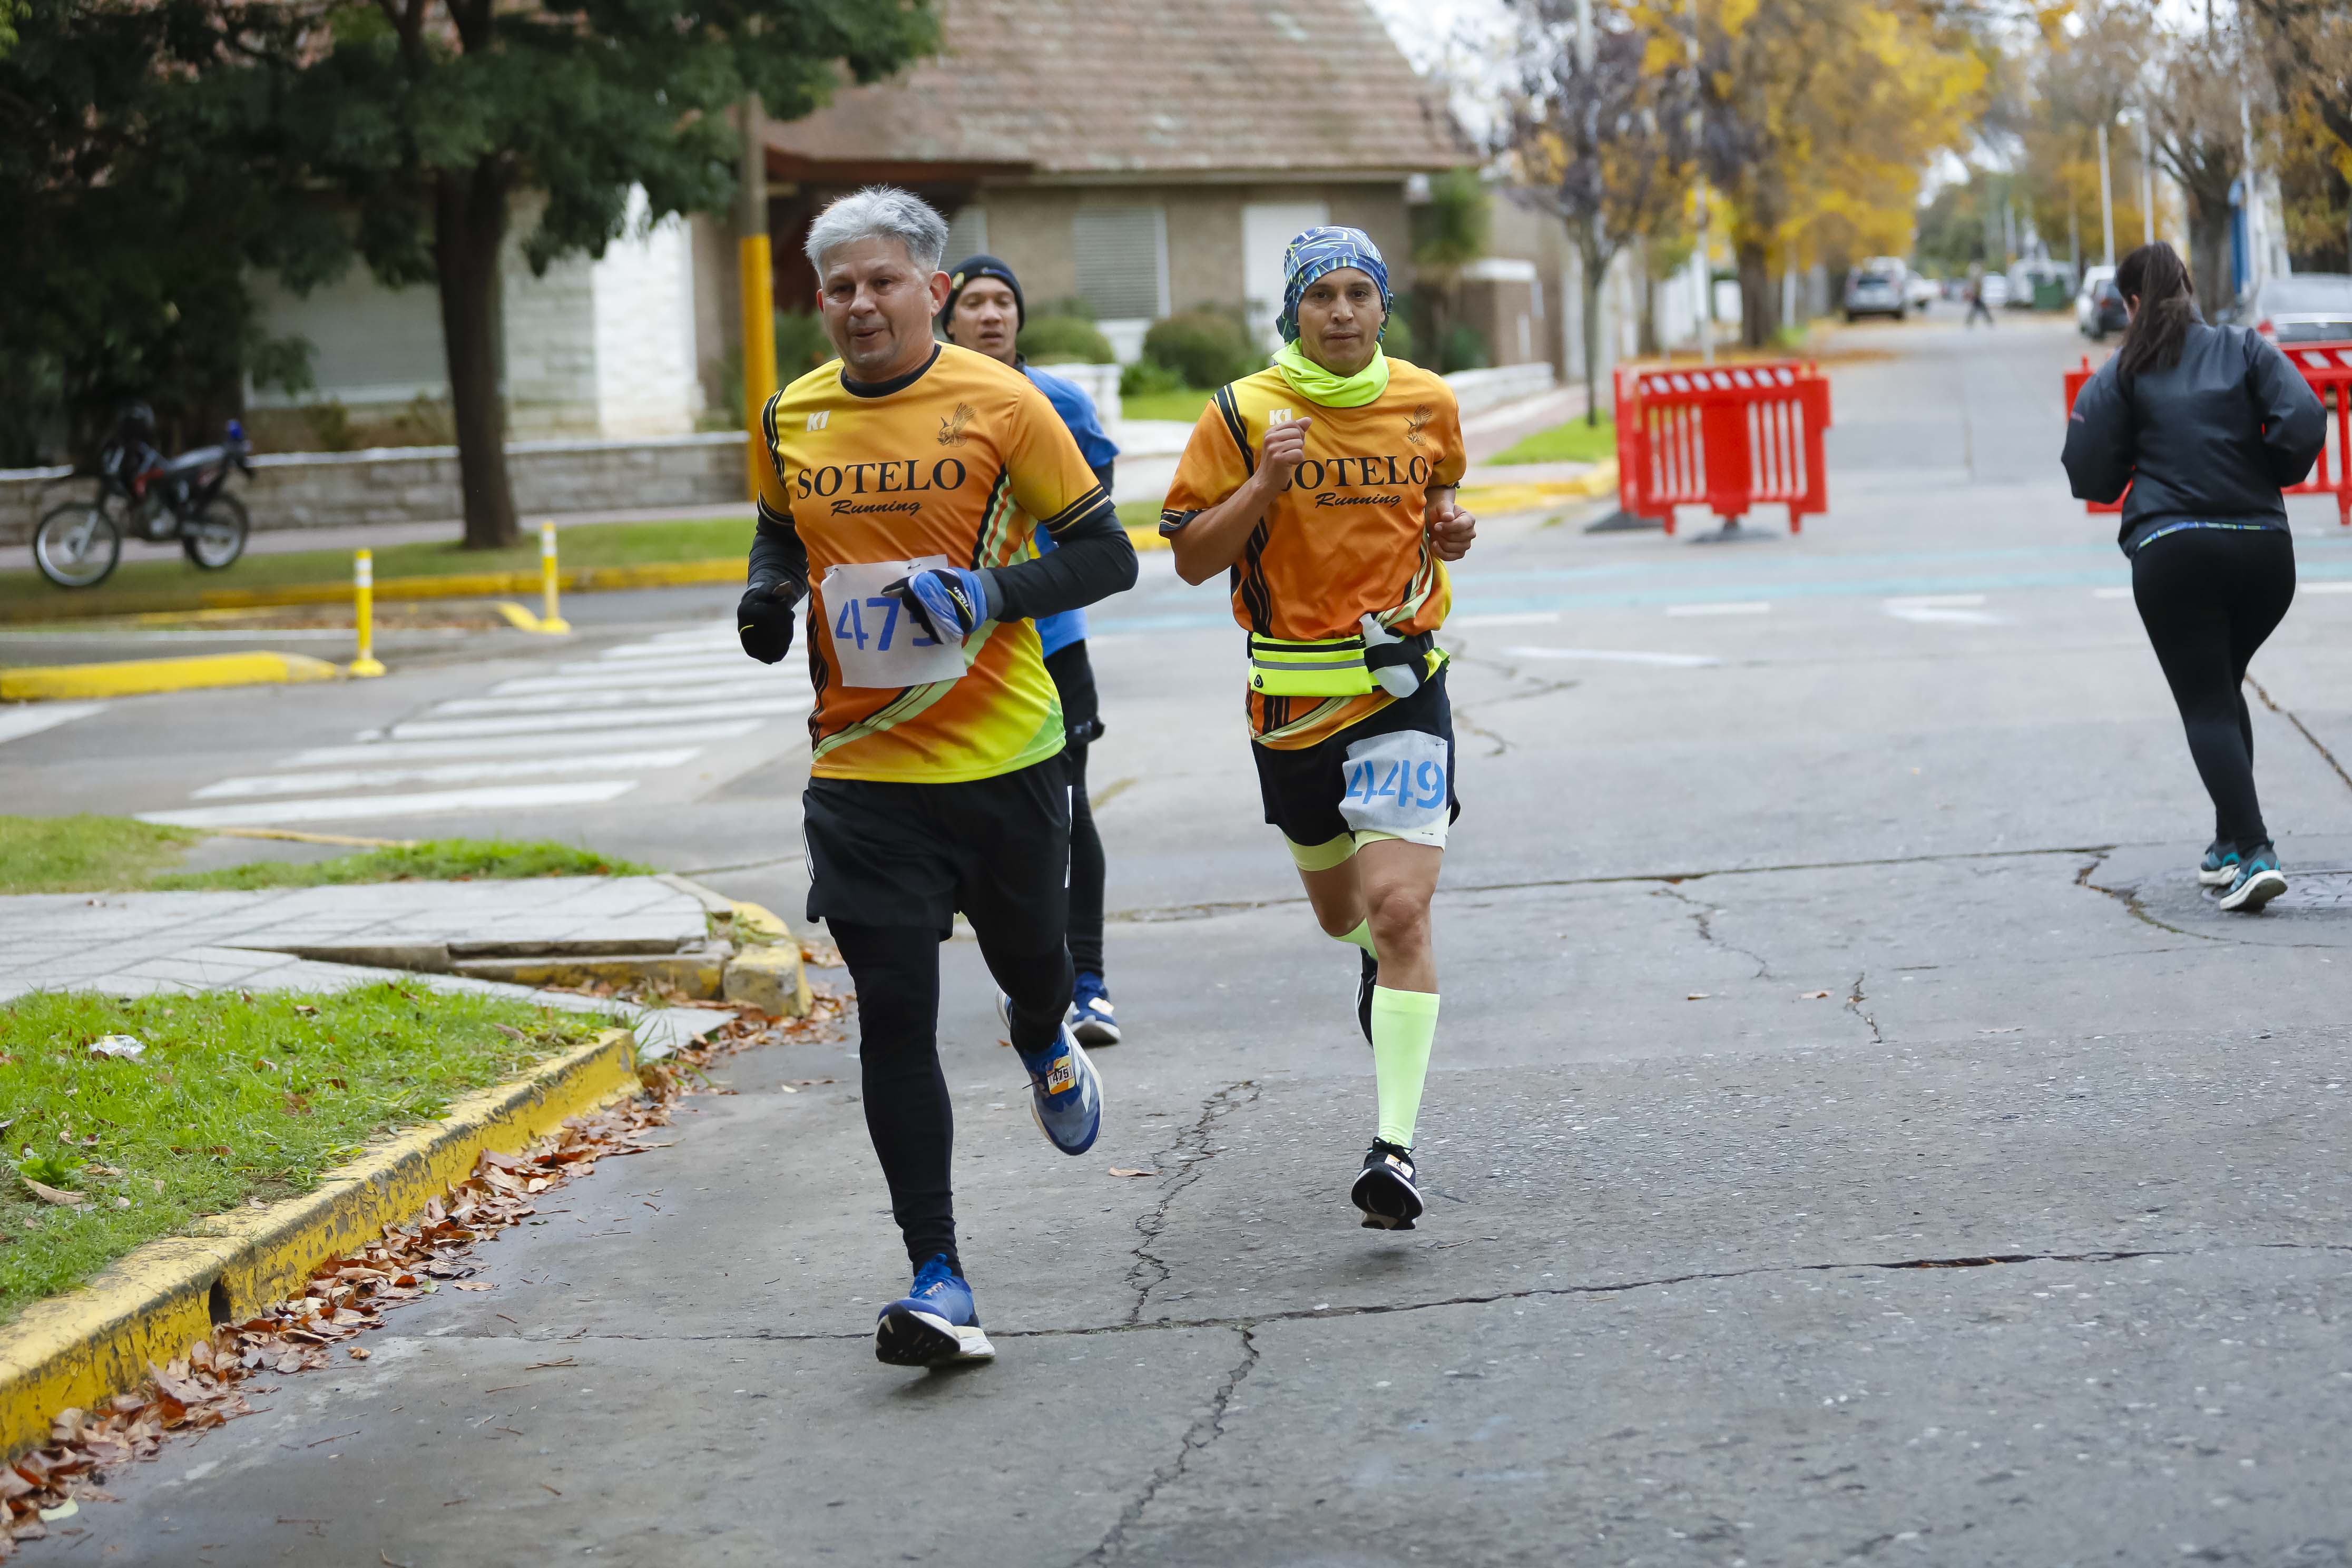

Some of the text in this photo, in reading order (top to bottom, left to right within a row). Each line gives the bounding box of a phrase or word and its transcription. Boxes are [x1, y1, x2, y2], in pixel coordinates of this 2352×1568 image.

[806, 410, 830, 432] K1
[1269, 408, 1292, 426] K1
[797, 458, 966, 500] SOTELO
[830, 499, 922, 516] Running
[1315, 492, 1402, 508] Running
[1346, 760, 1445, 809] 449
[1053, 1067, 1069, 1082] 475
